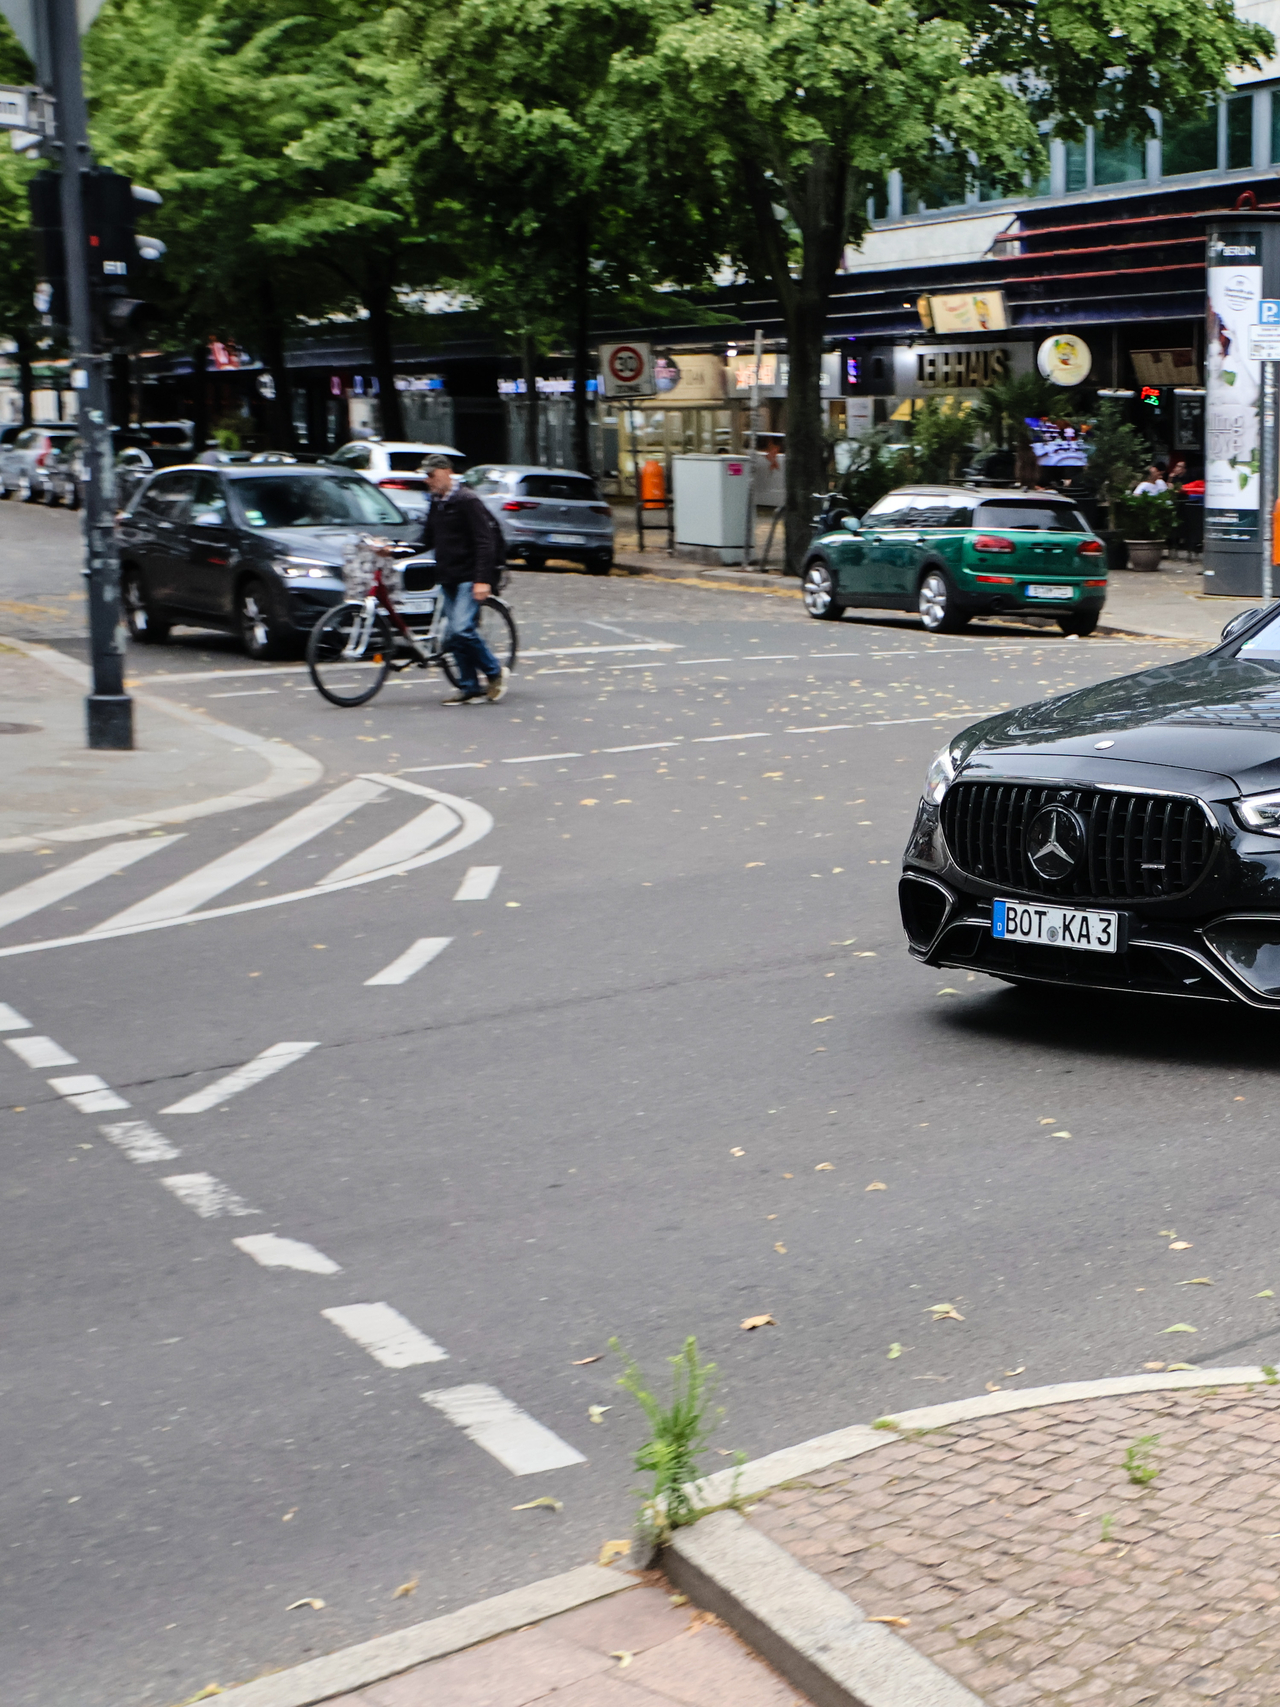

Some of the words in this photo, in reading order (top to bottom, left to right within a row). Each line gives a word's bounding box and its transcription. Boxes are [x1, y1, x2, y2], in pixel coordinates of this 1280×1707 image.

[1262, 303, 1279, 323] P
[616, 356, 639, 373] 30
[1006, 906, 1048, 938] BOT
